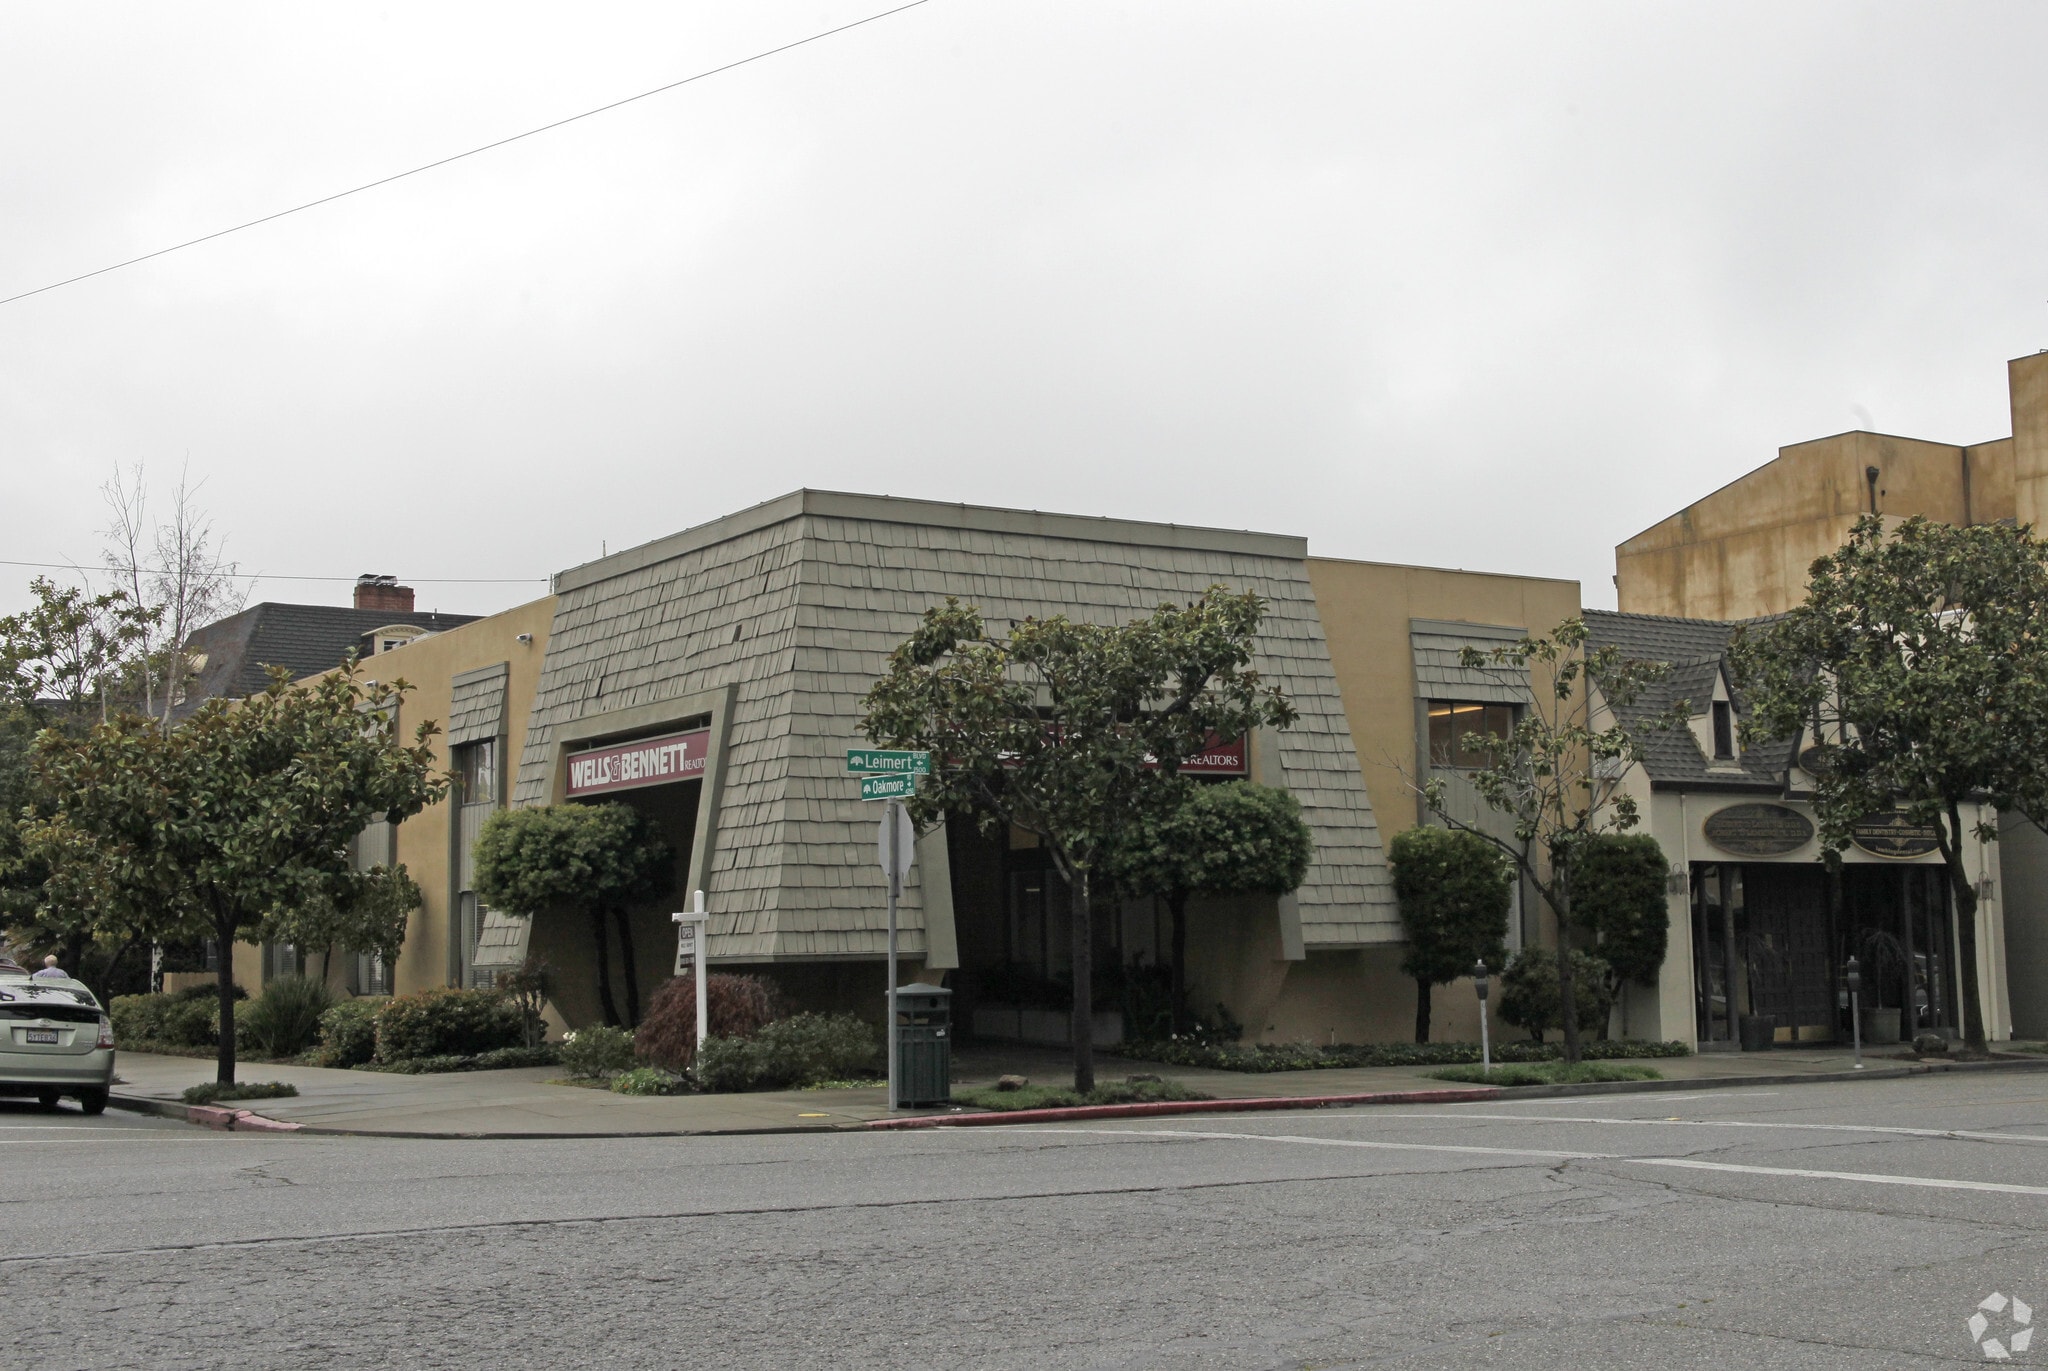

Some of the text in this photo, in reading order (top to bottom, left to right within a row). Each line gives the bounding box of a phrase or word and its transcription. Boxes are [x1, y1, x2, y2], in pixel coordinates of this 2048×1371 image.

[571, 757, 611, 789] WELLS
[621, 743, 687, 780] BENNETT
[685, 757, 707, 770] REALTO
[865, 754, 912, 770] Leimert
[1190, 754, 1239, 766] REALTORS
[872, 780, 904, 794] Oakmore
